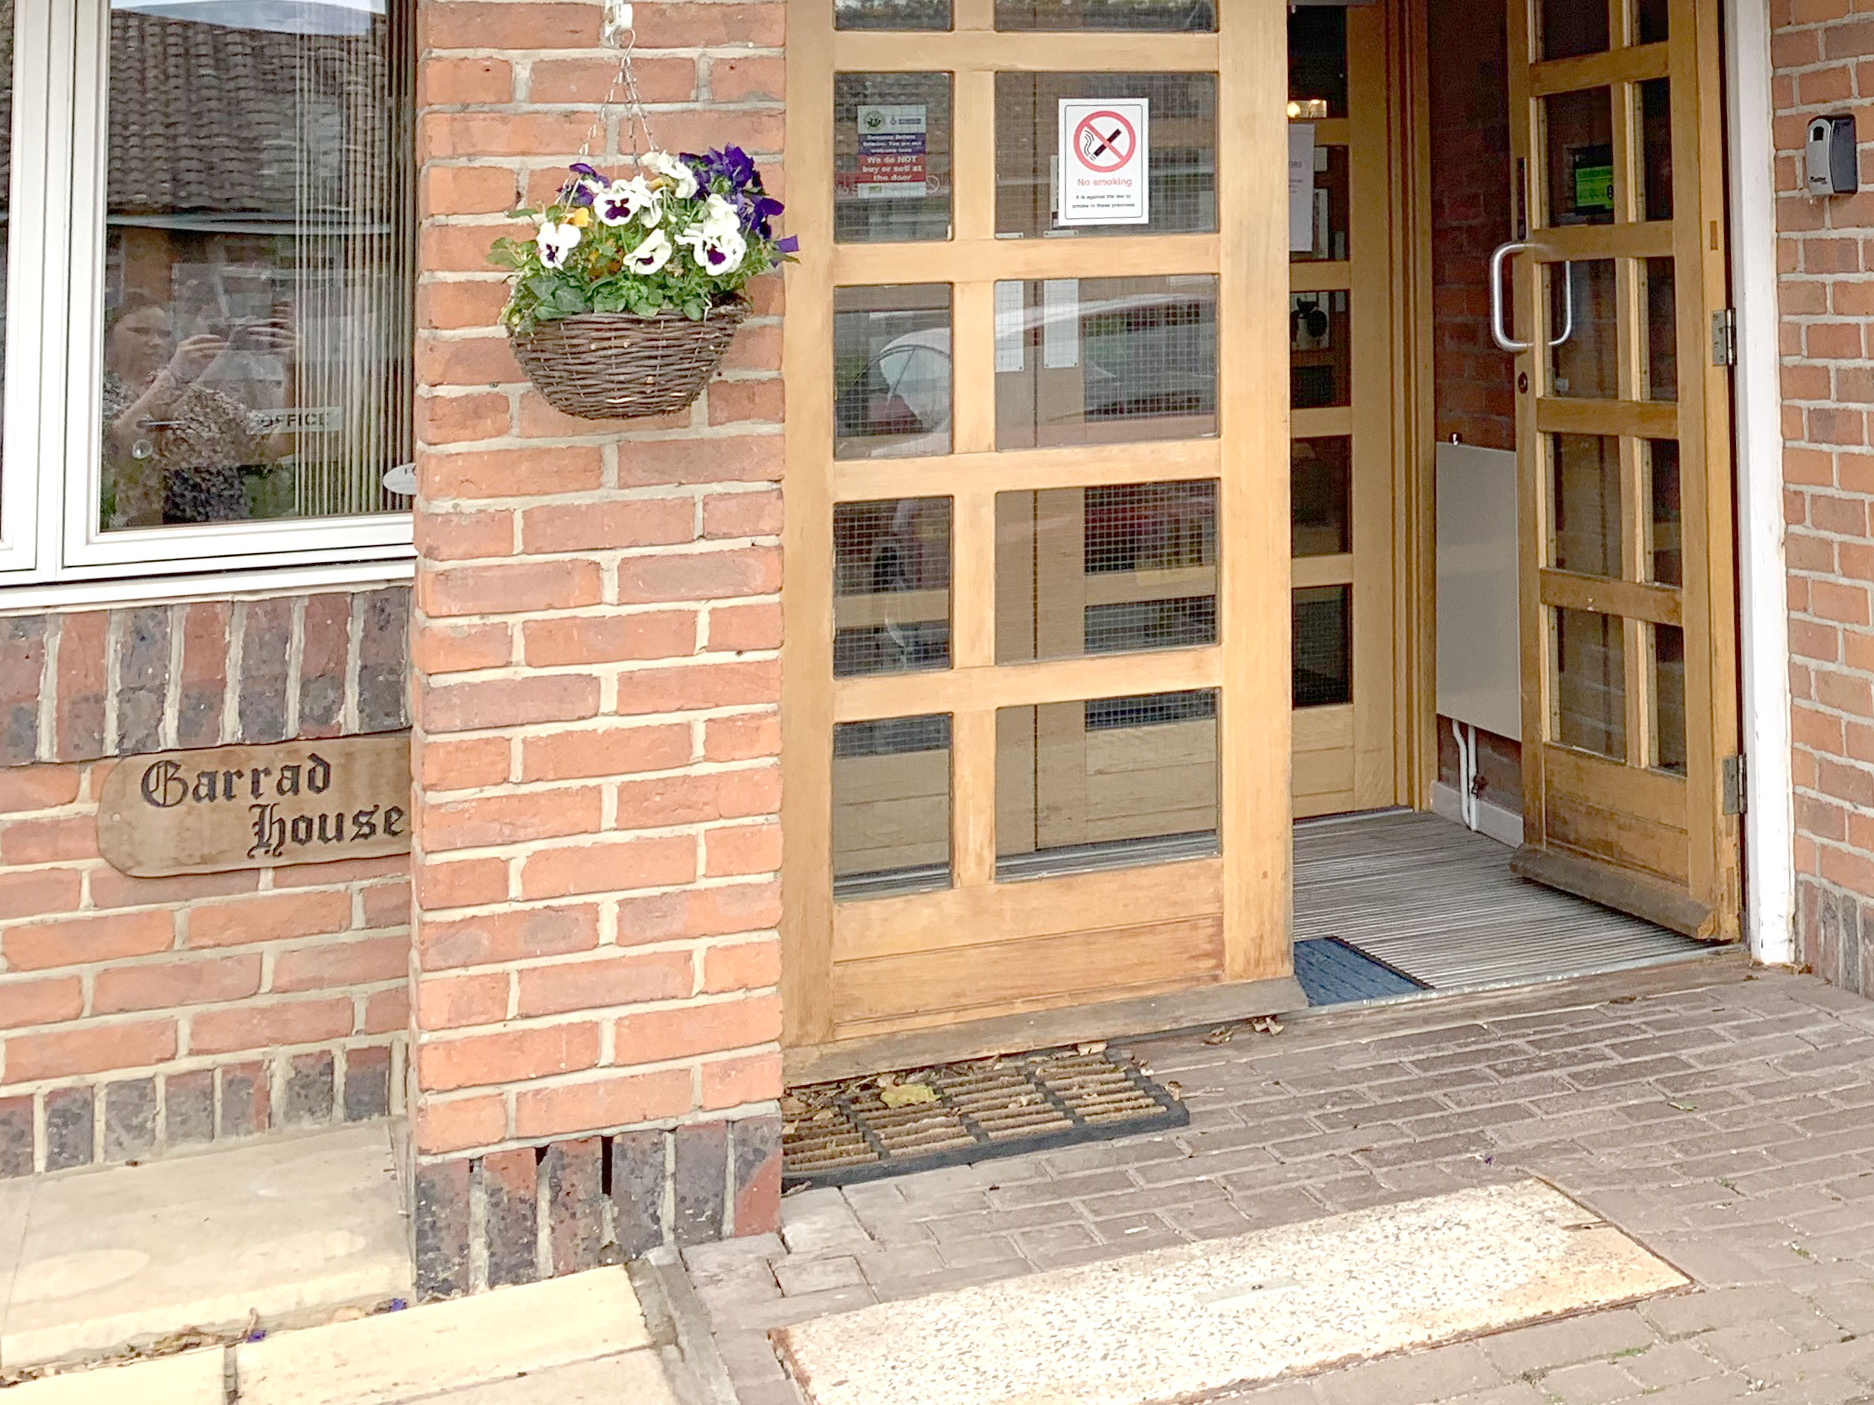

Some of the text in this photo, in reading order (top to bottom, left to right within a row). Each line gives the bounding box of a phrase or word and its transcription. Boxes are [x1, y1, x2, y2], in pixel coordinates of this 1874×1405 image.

[1077, 177, 1133, 188] No smoking
[141, 752, 332, 808] Garrad
[246, 802, 405, 858] House
